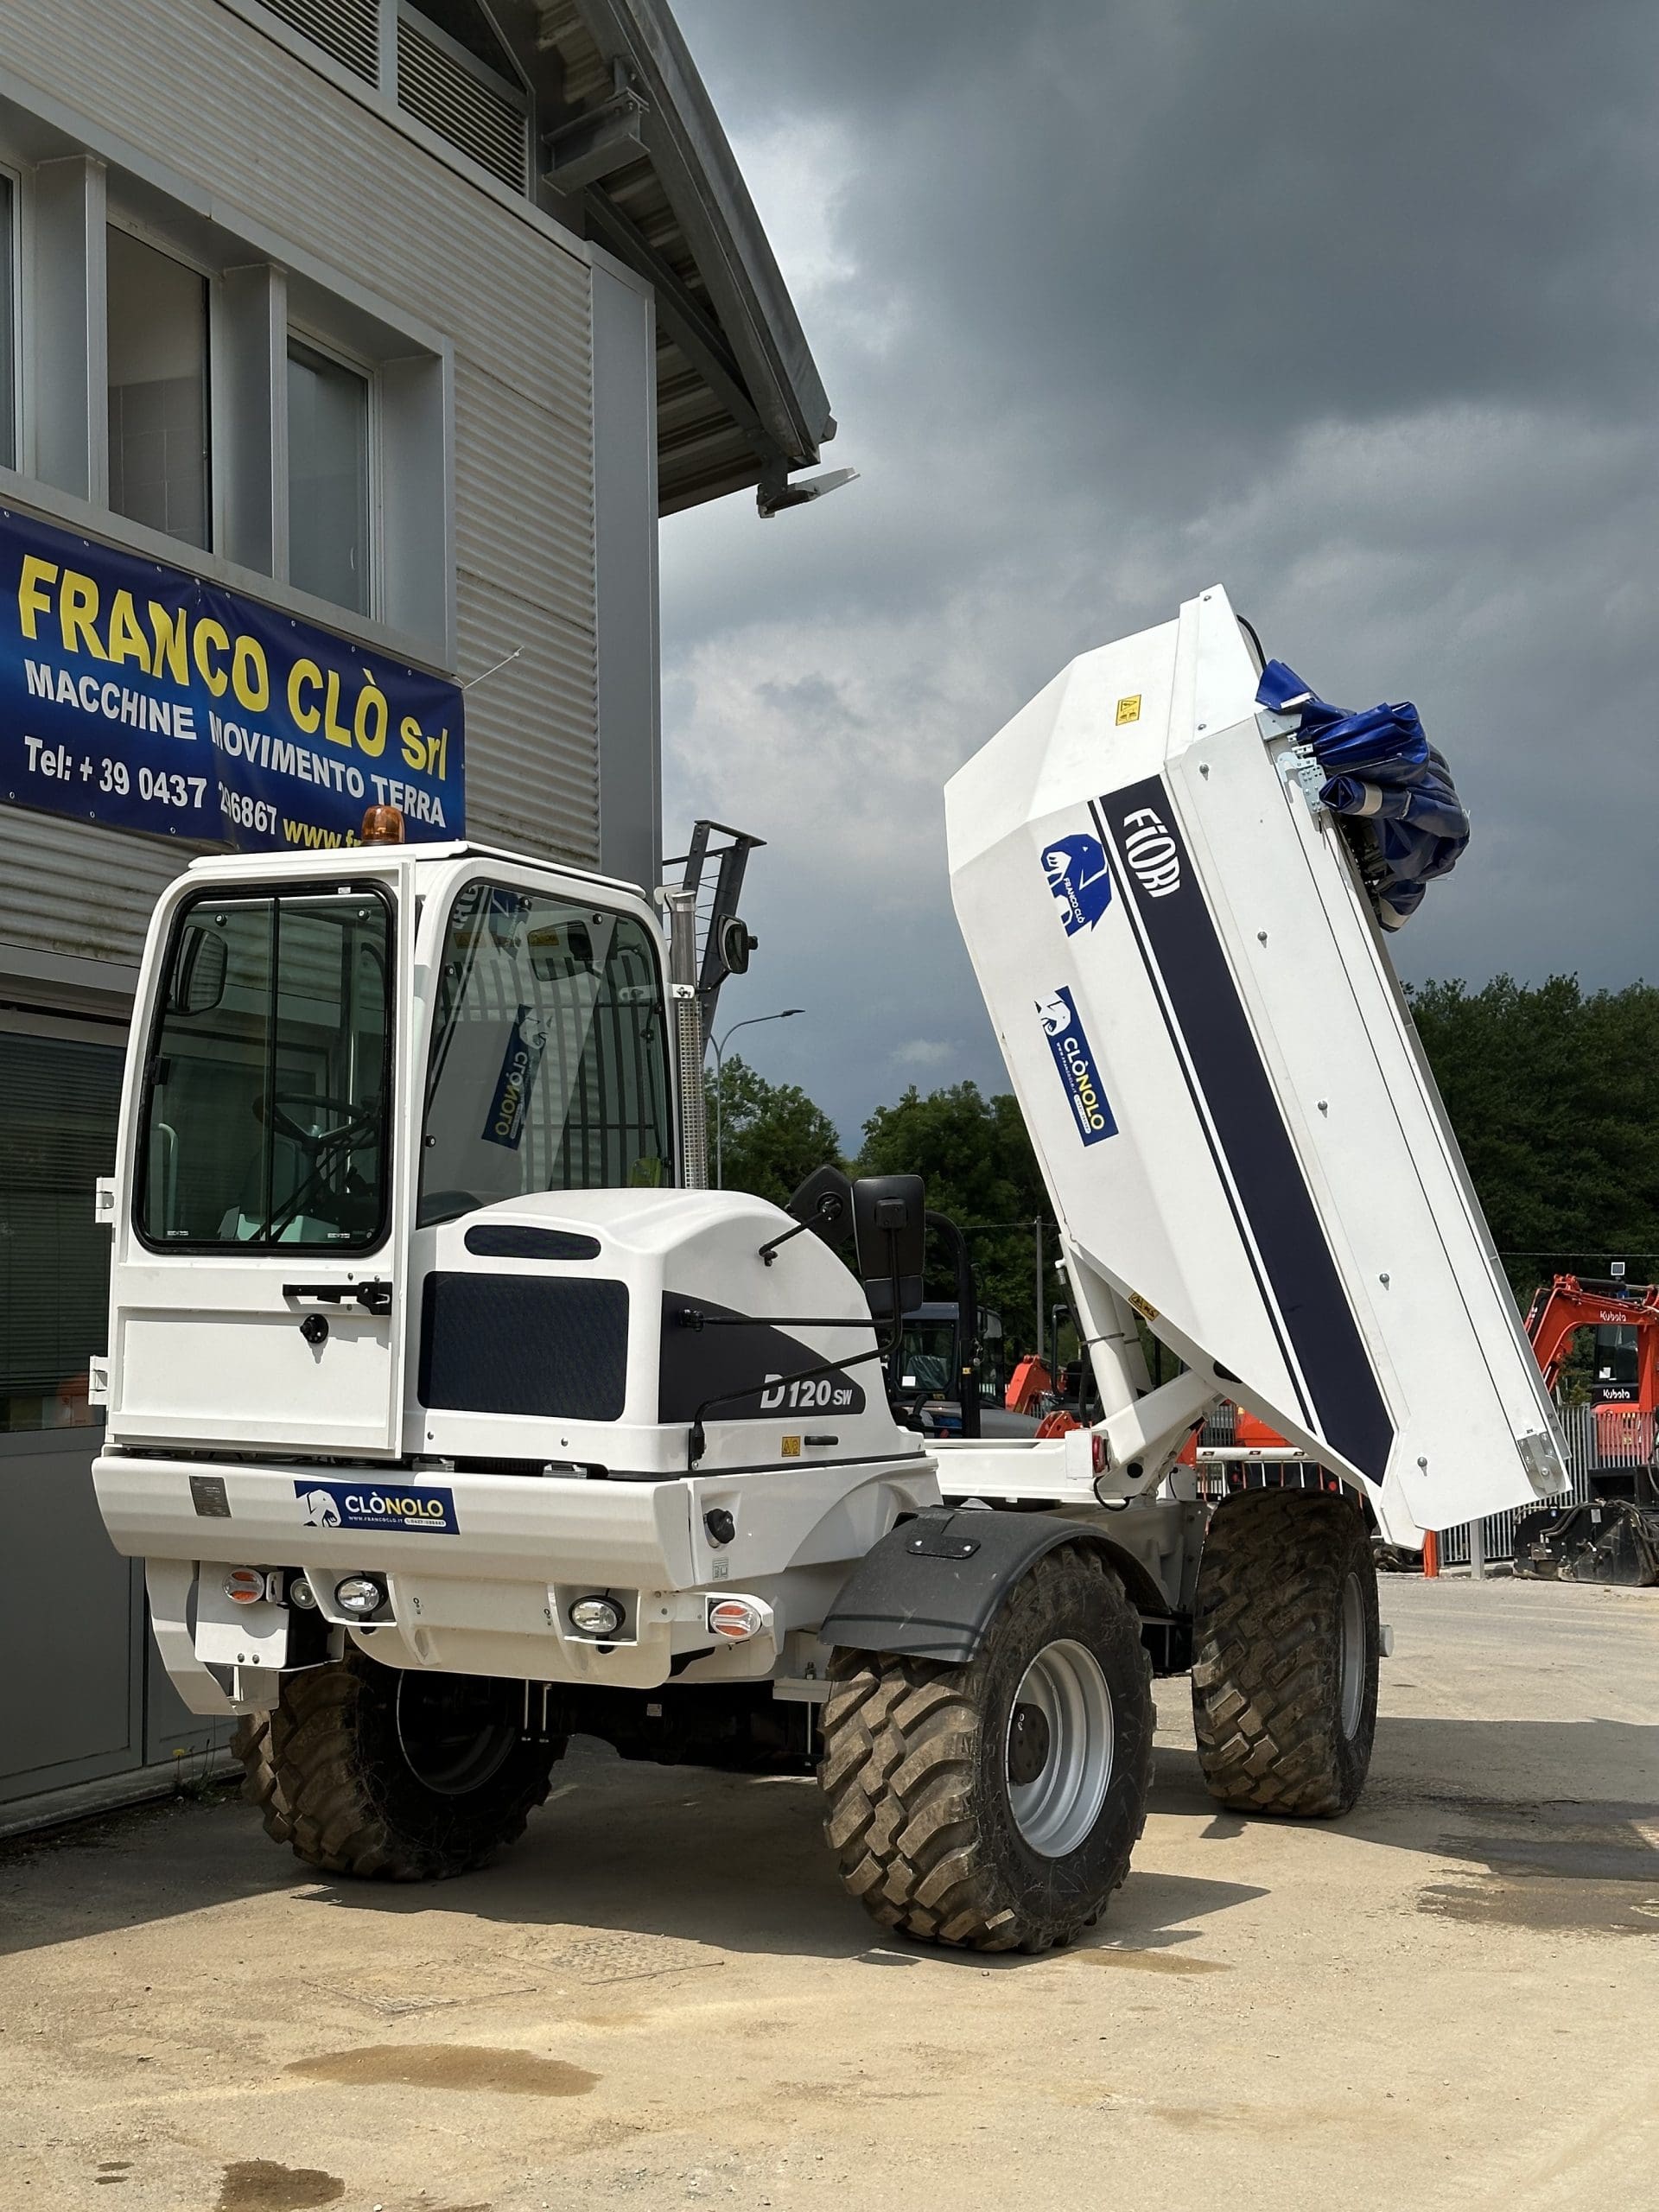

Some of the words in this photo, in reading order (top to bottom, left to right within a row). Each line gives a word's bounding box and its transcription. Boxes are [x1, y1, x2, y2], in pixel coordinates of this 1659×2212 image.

[18, 554, 270, 712] FRANCO
[287, 658, 389, 758] CLÒ
[400, 716, 448, 781] Srl
[24, 658, 198, 741] MACCHINE
[209, 710, 365, 798] MOVIMENTO
[371, 774, 446, 829] TERRA
[24, 735, 73, 781] Tel:
[79, 756, 93, 782] +
[99, 758, 130, 795] 39
[138, 767, 207, 808] 0437
[218, 780, 277, 835] 296867
[1063, 877, 1079, 908] FRANCO
[1064, 1037, 1105, 1130] CLÒNOLO
[1599, 1310, 1626, 1322] Kubota
[1603, 1389, 1630, 1399] Kubota
[345, 1491, 443, 1517] CLÒNOLO
